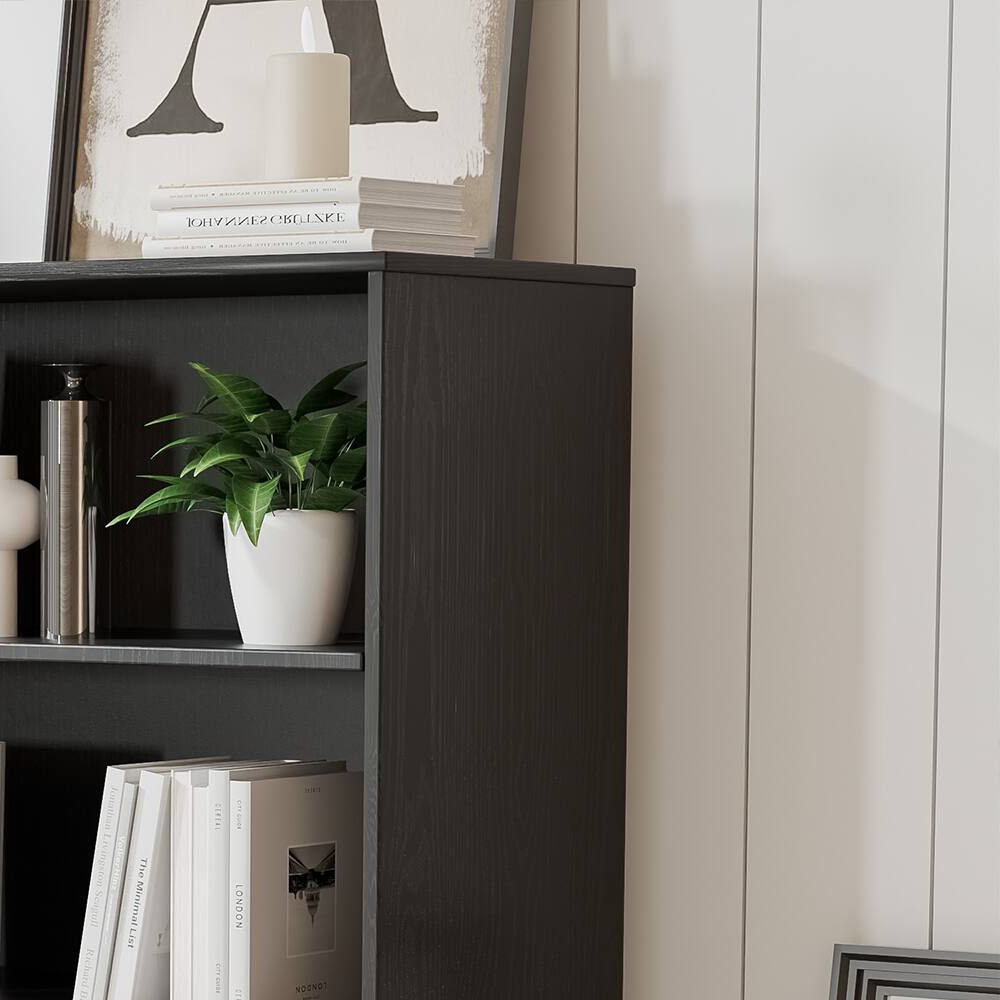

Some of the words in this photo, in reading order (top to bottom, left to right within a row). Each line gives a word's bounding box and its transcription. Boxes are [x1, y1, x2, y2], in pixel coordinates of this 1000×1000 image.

[137, 857, 149, 880] The
[130, 880, 146, 927] Minimal
[235, 883, 244, 930] LONDON
[126, 927, 139, 949] List
[80, 947, 97, 988] Richard
